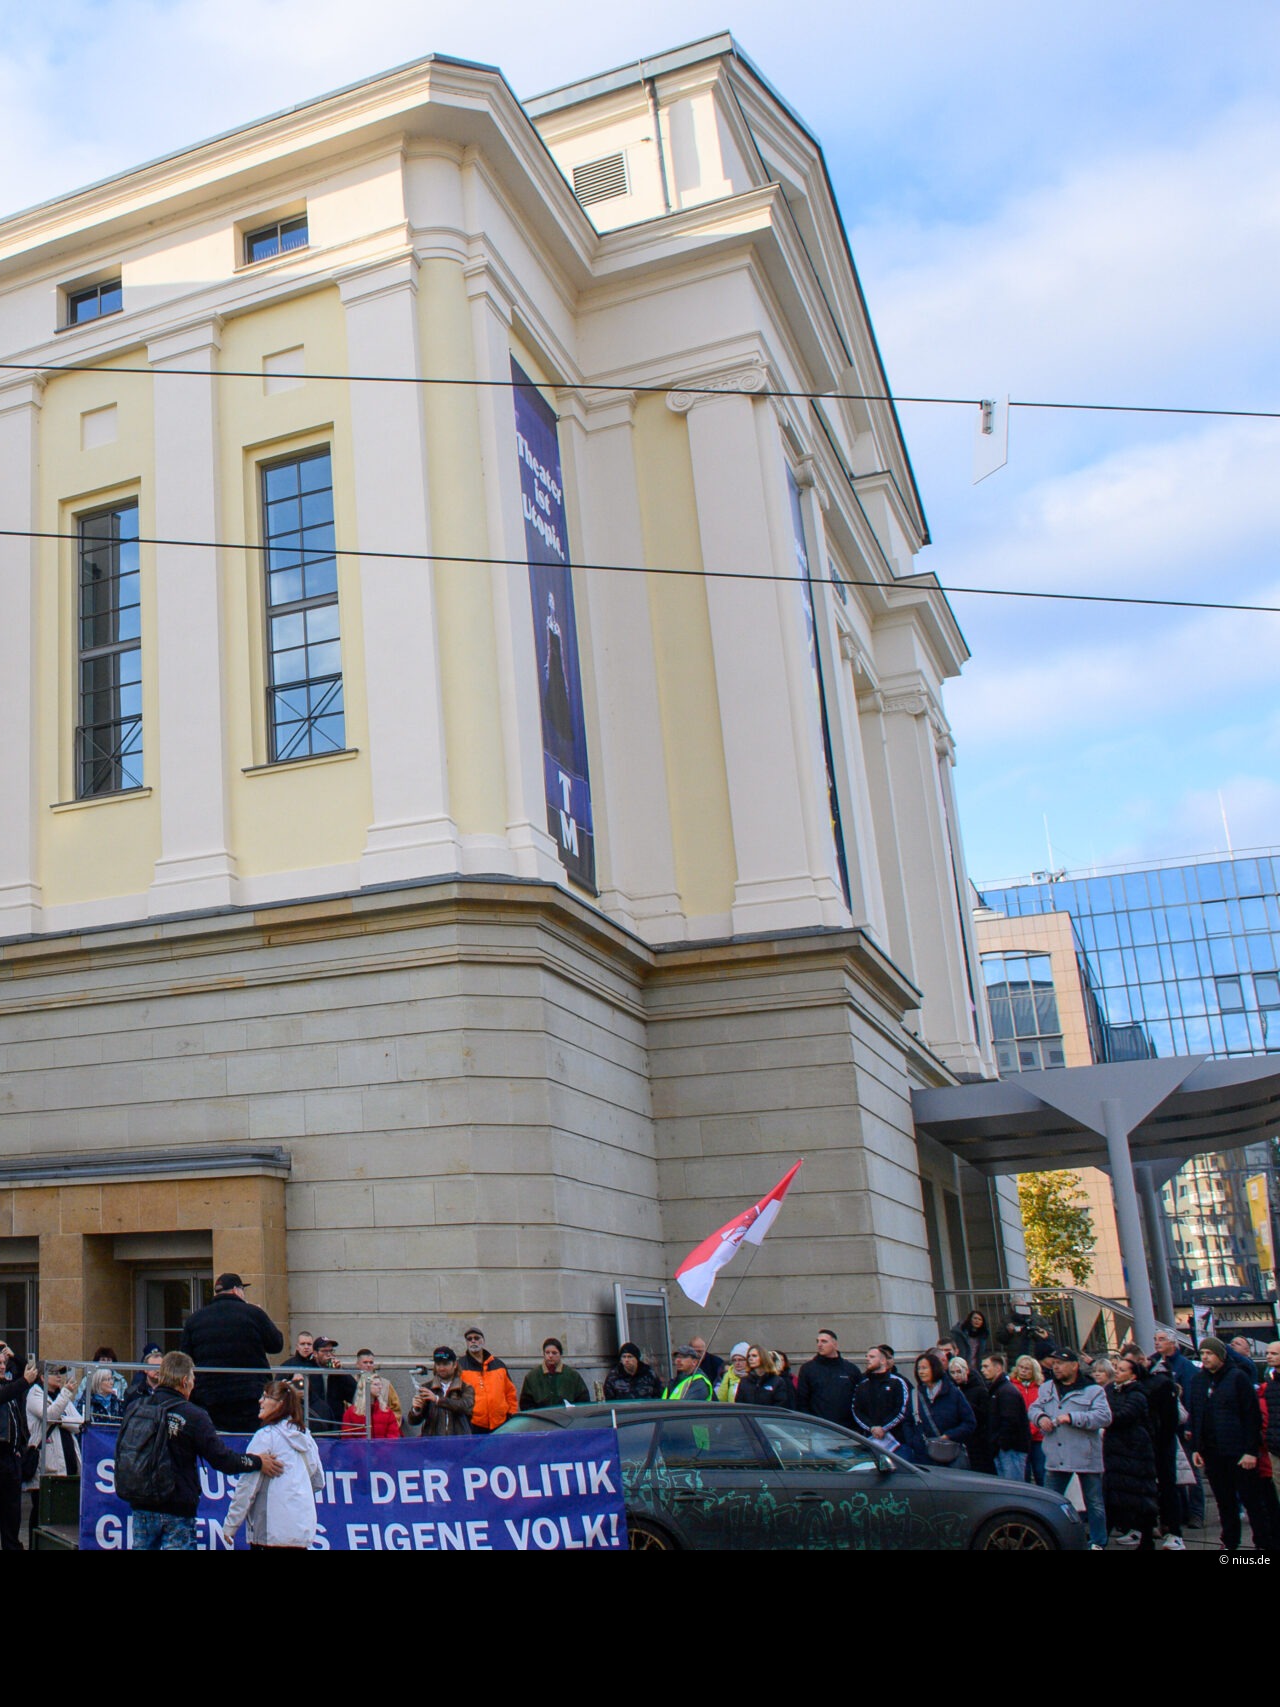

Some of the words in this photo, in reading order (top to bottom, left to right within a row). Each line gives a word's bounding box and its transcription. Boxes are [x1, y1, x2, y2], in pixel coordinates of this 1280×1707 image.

[516, 432, 562, 505] Theater
[534, 478, 551, 516] ist
[522, 493, 566, 561] Utopie.
[1214, 1311, 1272, 1322] AURANT
[315, 1471, 358, 1504] IT
[370, 1469, 451, 1504] DER
[462, 1460, 616, 1501] POLITIK
[346, 1521, 493, 1550] EIGENE
[504, 1514, 620, 1550] VOLK!
